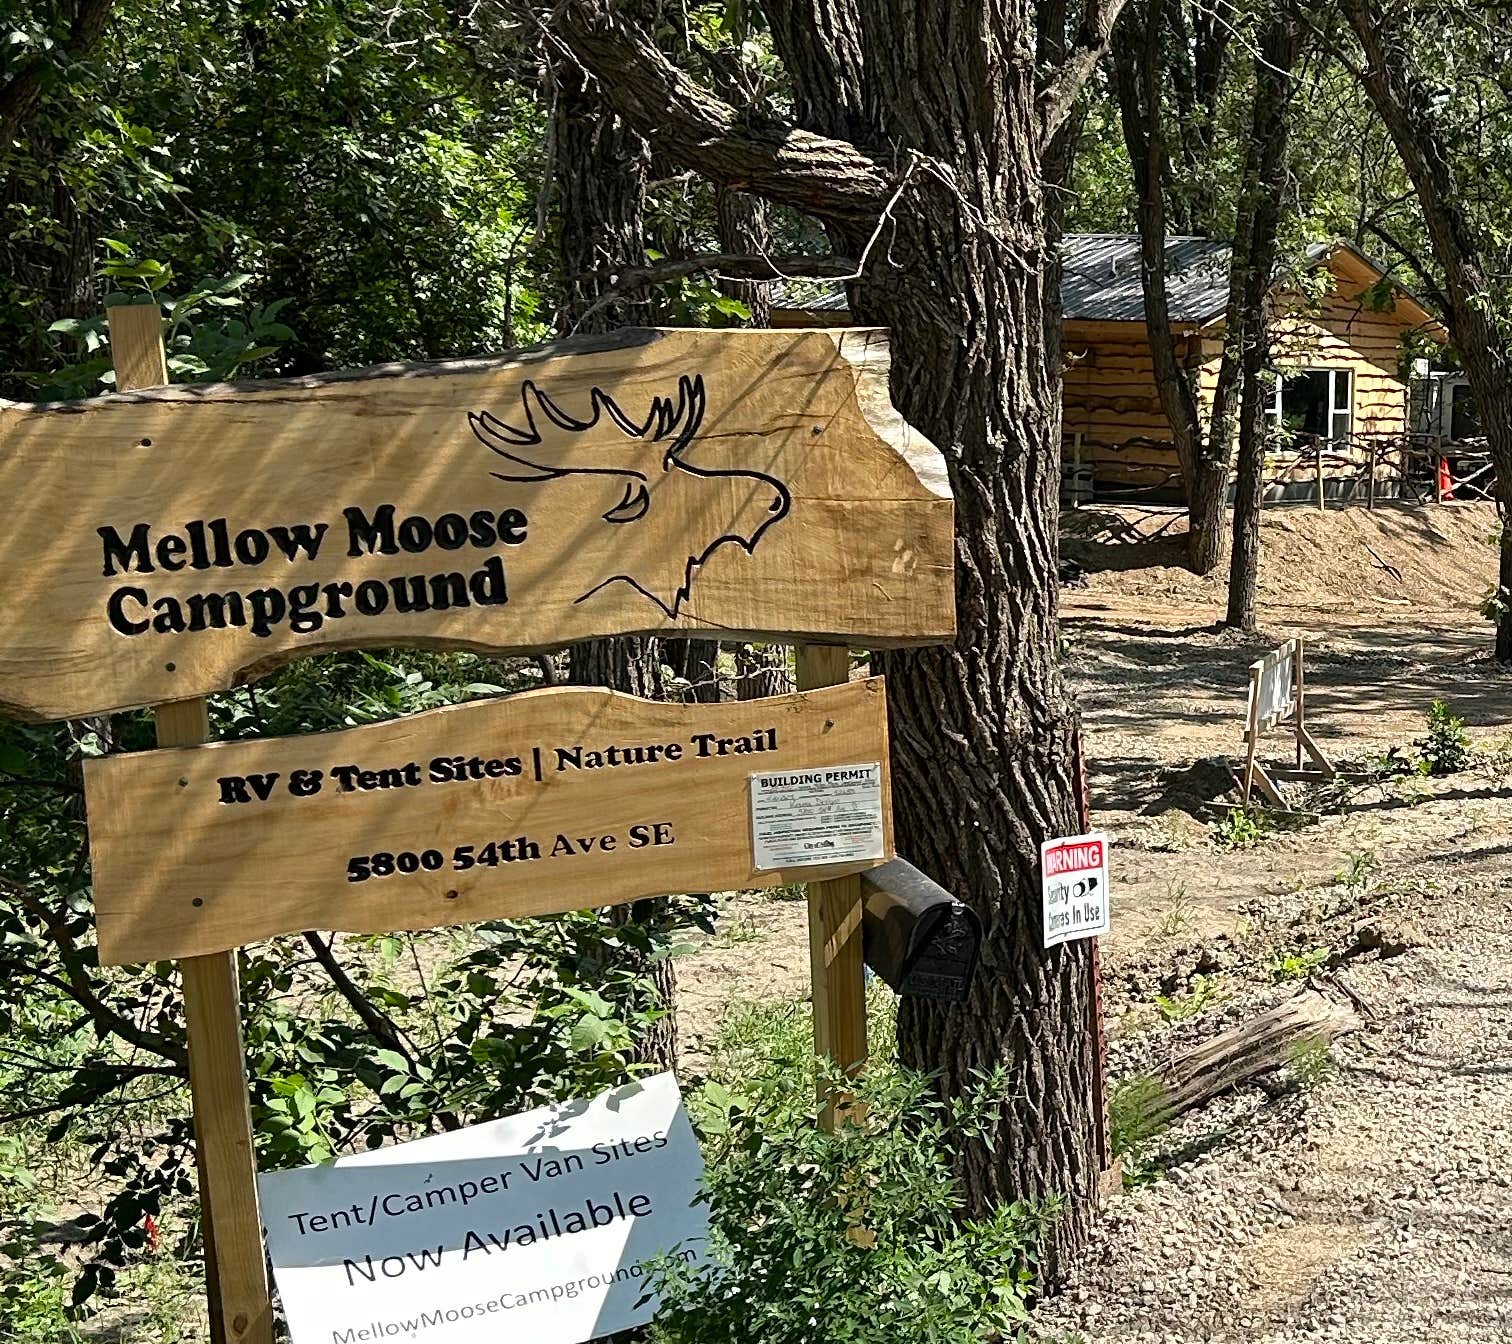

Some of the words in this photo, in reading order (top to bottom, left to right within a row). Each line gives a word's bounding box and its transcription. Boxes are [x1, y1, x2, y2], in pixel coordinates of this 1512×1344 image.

[97, 518, 329, 577] Mellow
[342, 504, 528, 557] Moose
[107, 556, 509, 638] Campground
[217, 773, 280, 804] RV
[288, 769, 324, 797] &
[330, 762, 422, 792] Tent
[429, 755, 522, 784] Sites
[554, 743, 682, 772] Nature
[690, 728, 778, 758] Trail
[760, 773, 822, 788] BUILDING
[826, 769, 872, 783] PERMIT
[347, 849, 444, 883] 5800
[453, 836, 541, 871] 54th
[550, 833, 617, 857] Ave
[628, 822, 675, 848] SE
[1073, 905, 1081, 925] In
[1084, 903, 1100, 923] Use
[287, 1170, 512, 1236] Tent/Camper
[519, 1154, 583, 1183] Van
[591, 1130, 669, 1165] Sites
[343, 1244, 444, 1287] Now
[462, 1191, 654, 1261] Available
